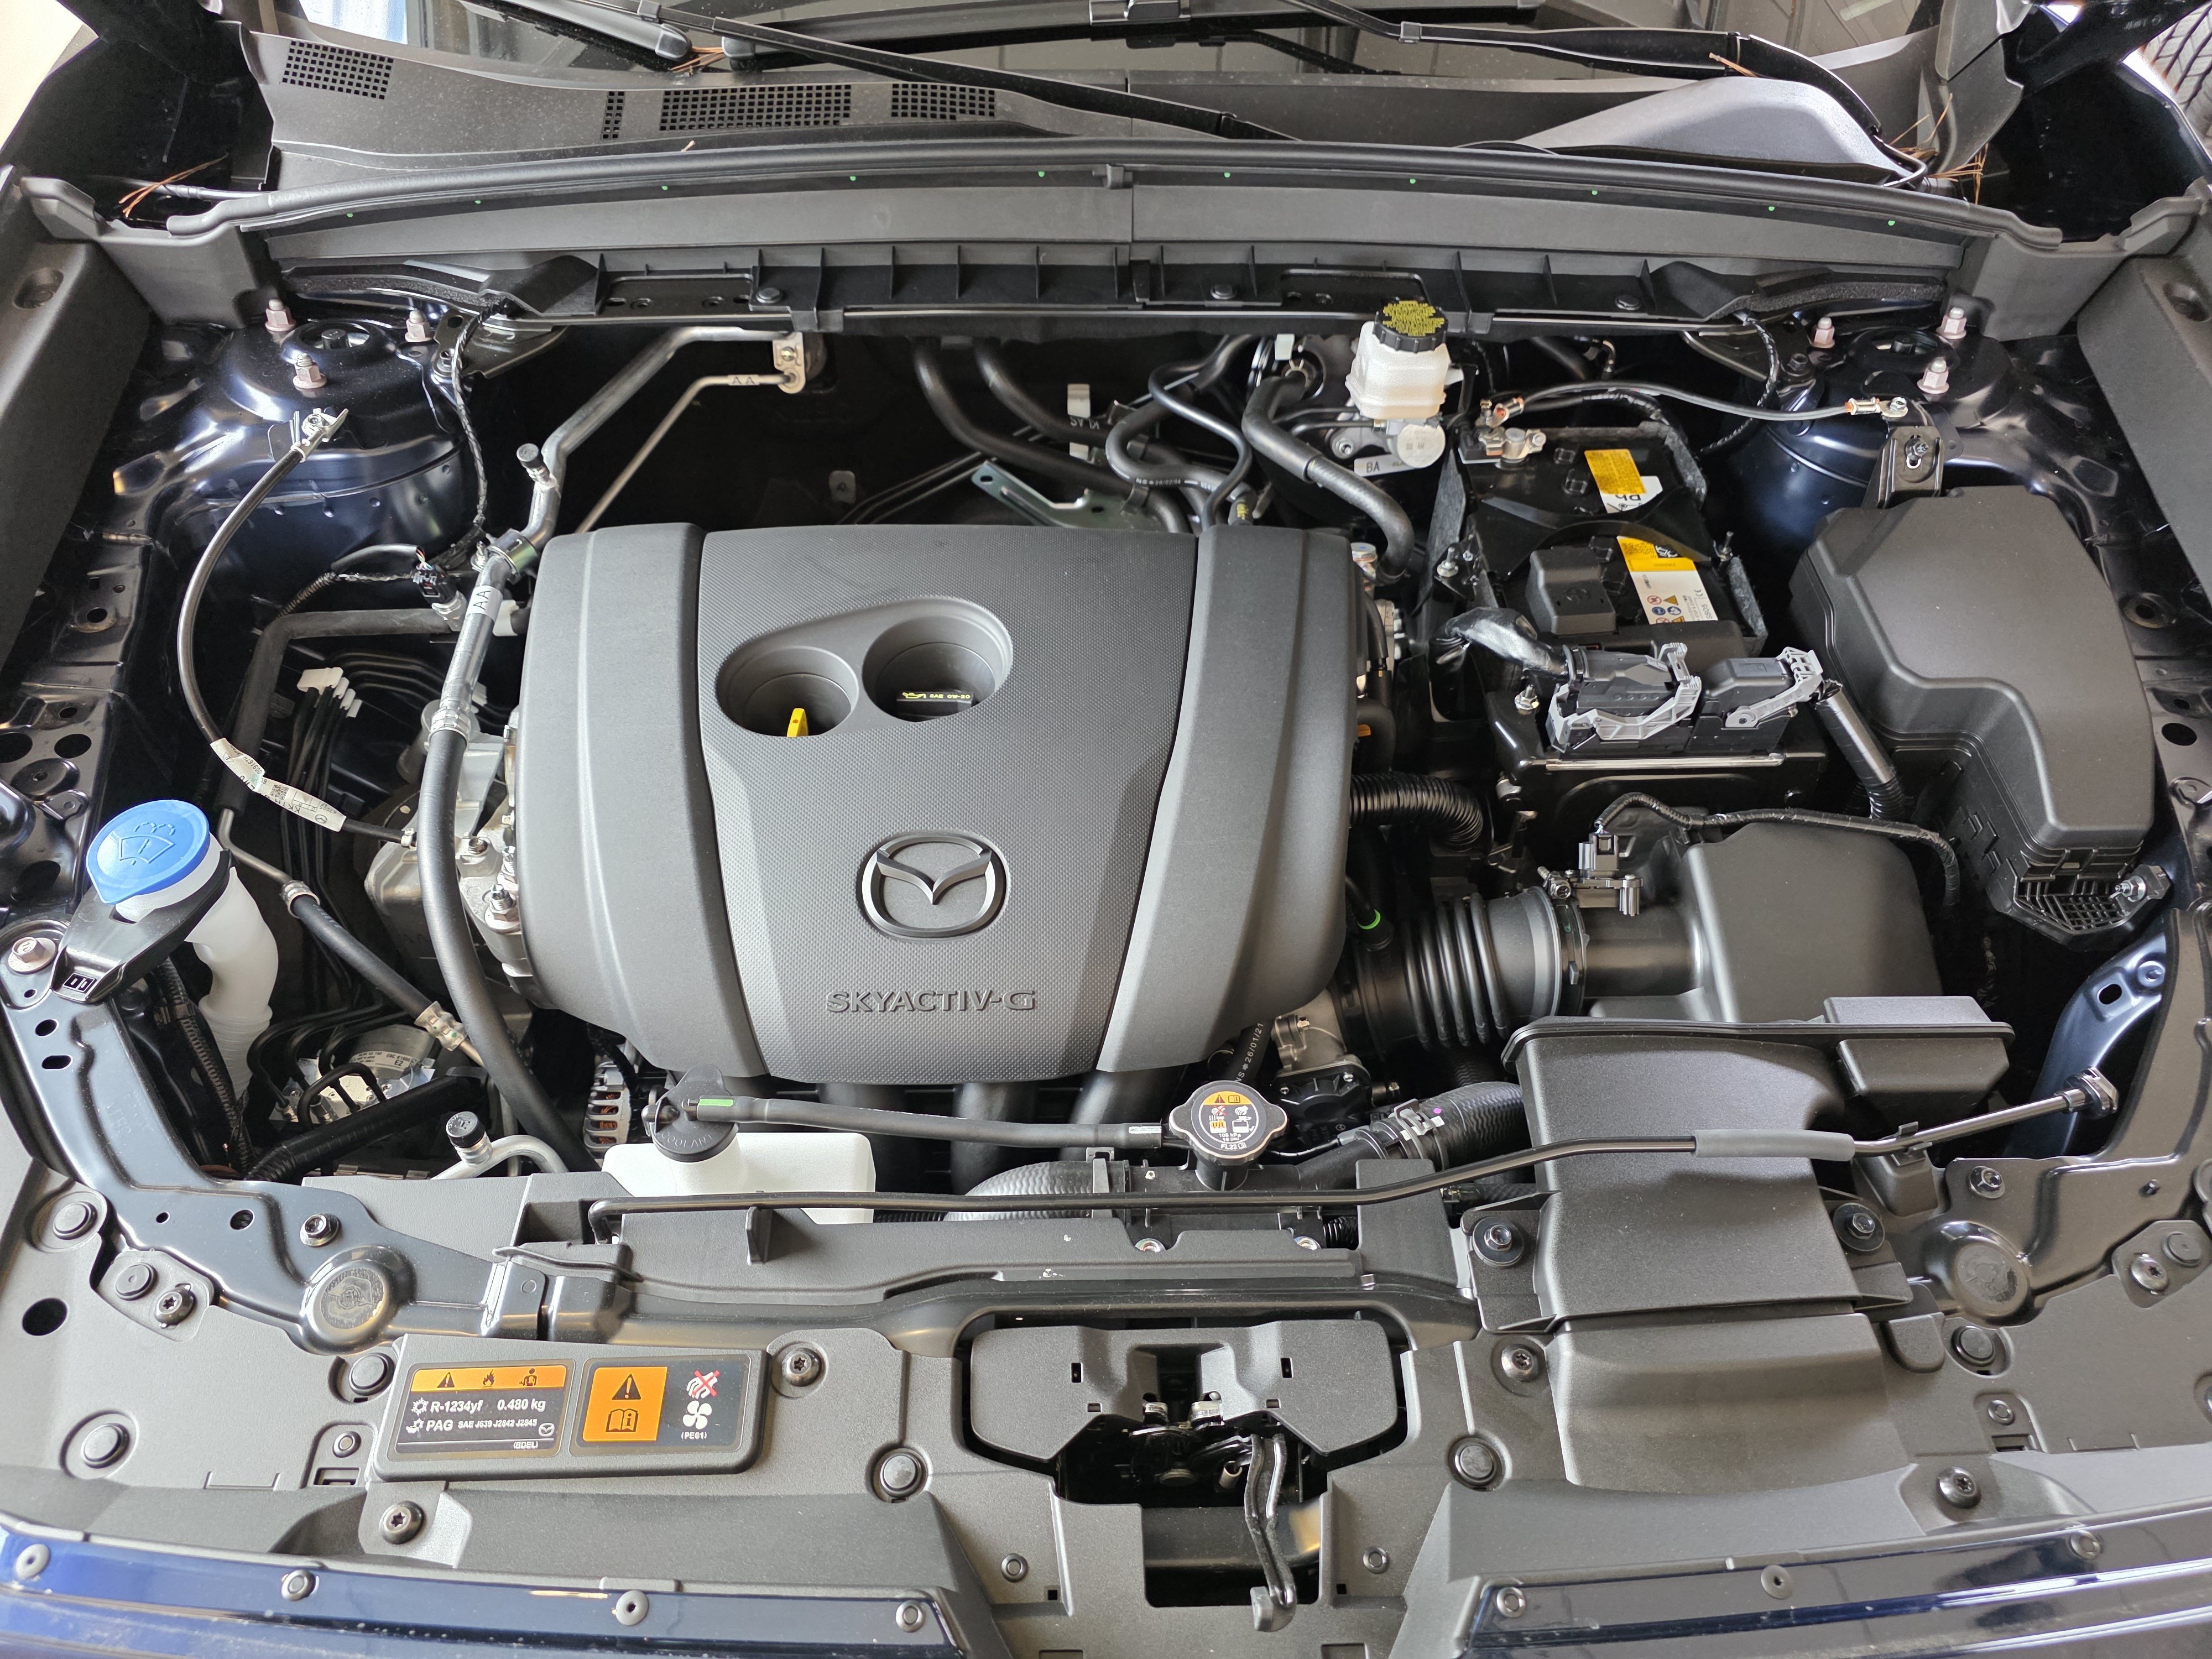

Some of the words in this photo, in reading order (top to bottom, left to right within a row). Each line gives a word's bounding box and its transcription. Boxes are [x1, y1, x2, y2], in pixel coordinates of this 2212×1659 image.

[1366, 460, 1380, 473] BA
[472, 590, 492, 611] AA
[825, 989, 1036, 1013] SKYACTIV-G
[1244, 1022, 1264, 1063] 26/01/21
[430, 1400, 484, 1414] R-1234yf
[497, 1399, 529, 1411] 0.480
[530, 1398, 546, 1412] kg
[425, 1419, 453, 1432] PAG
[457, 1420, 474, 1429] SAE
[474, 1420, 493, 1429] J639
[681, 1431, 707, 1439] (PE01)
[513, 1441, 539, 1449] (BDEL)
